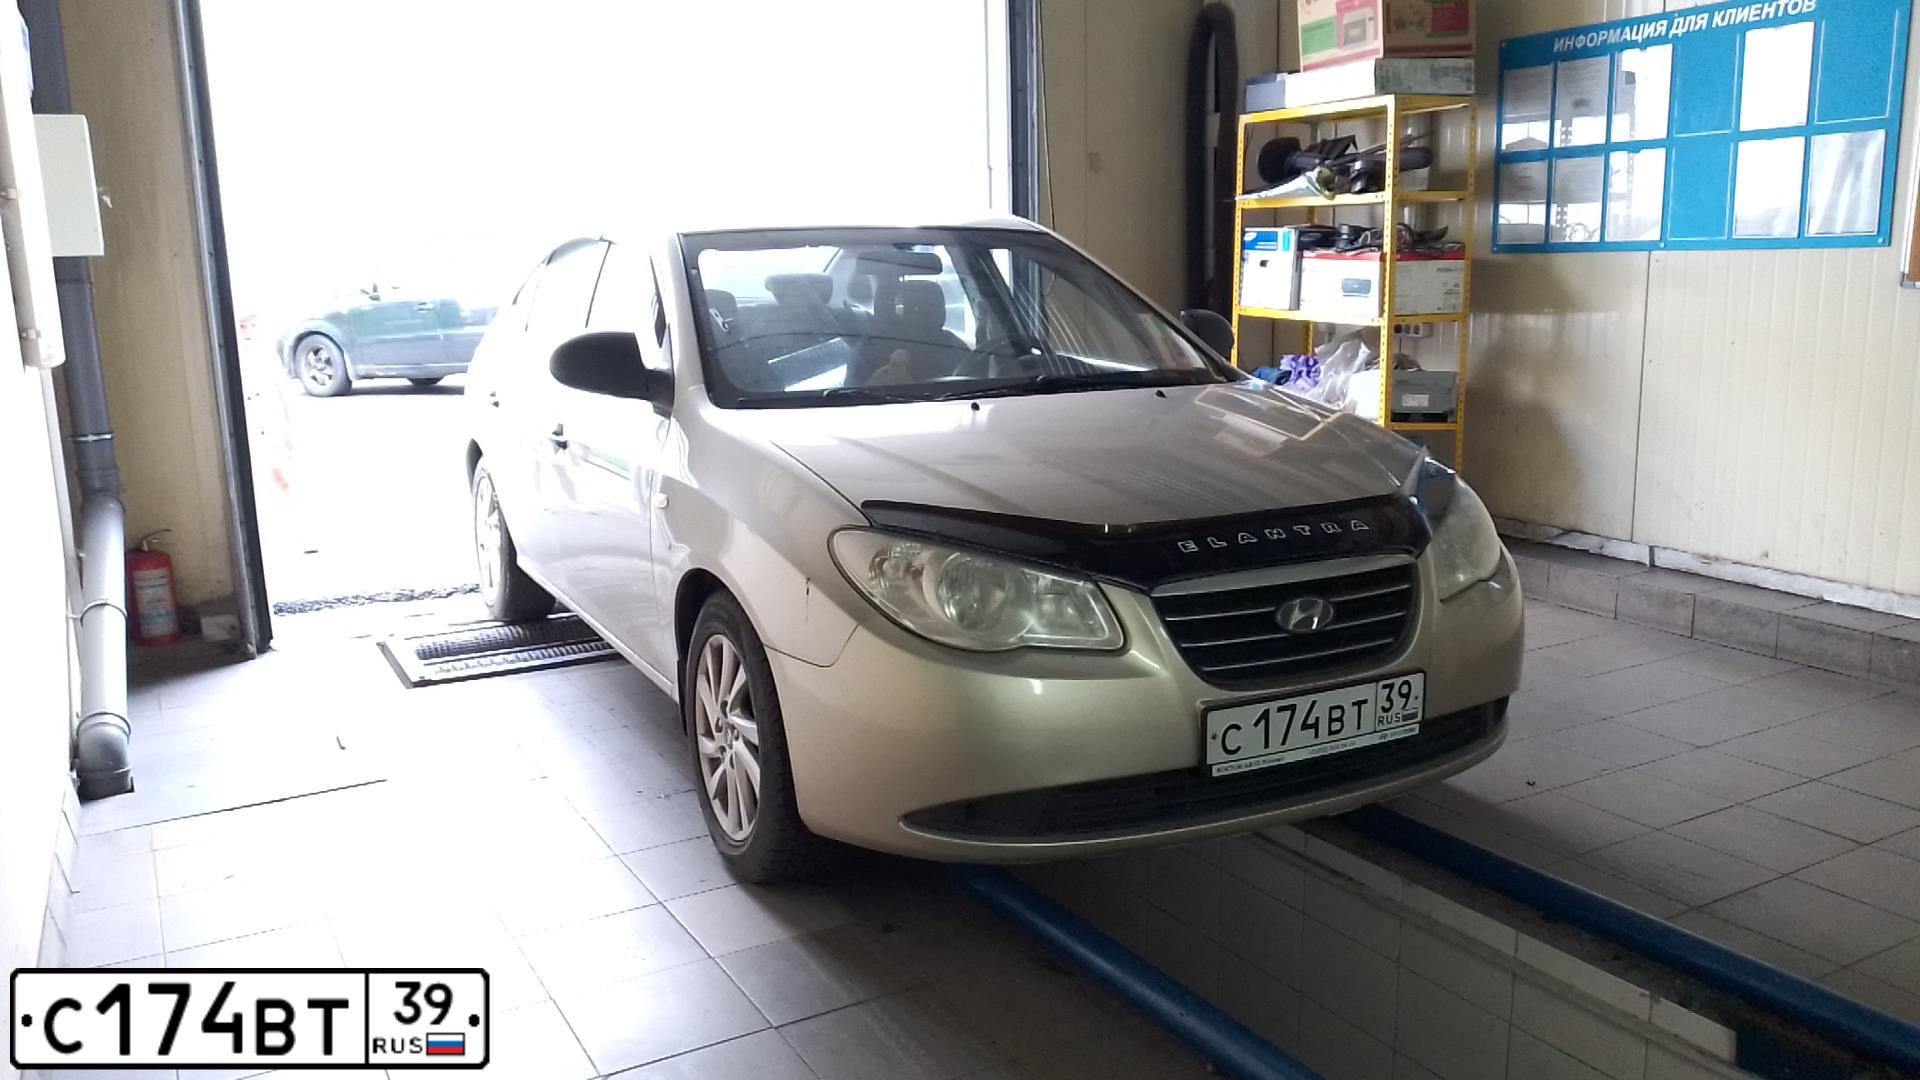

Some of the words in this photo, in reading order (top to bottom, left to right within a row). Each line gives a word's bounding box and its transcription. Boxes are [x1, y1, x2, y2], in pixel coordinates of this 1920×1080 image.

[1552, 20, 1669, 53] ИНФОРМАЦИЯ
[1668, 12, 1709, 39] ДЛЯ
[1711, 0, 1817, 28] КЛИЕНТОВ
[1177, 519, 1370, 553] ELANTRA
[1221, 699, 1369, 755] С174ВТ
[1381, 679, 1413, 714] 39
[1377, 712, 1401, 727] RUS
